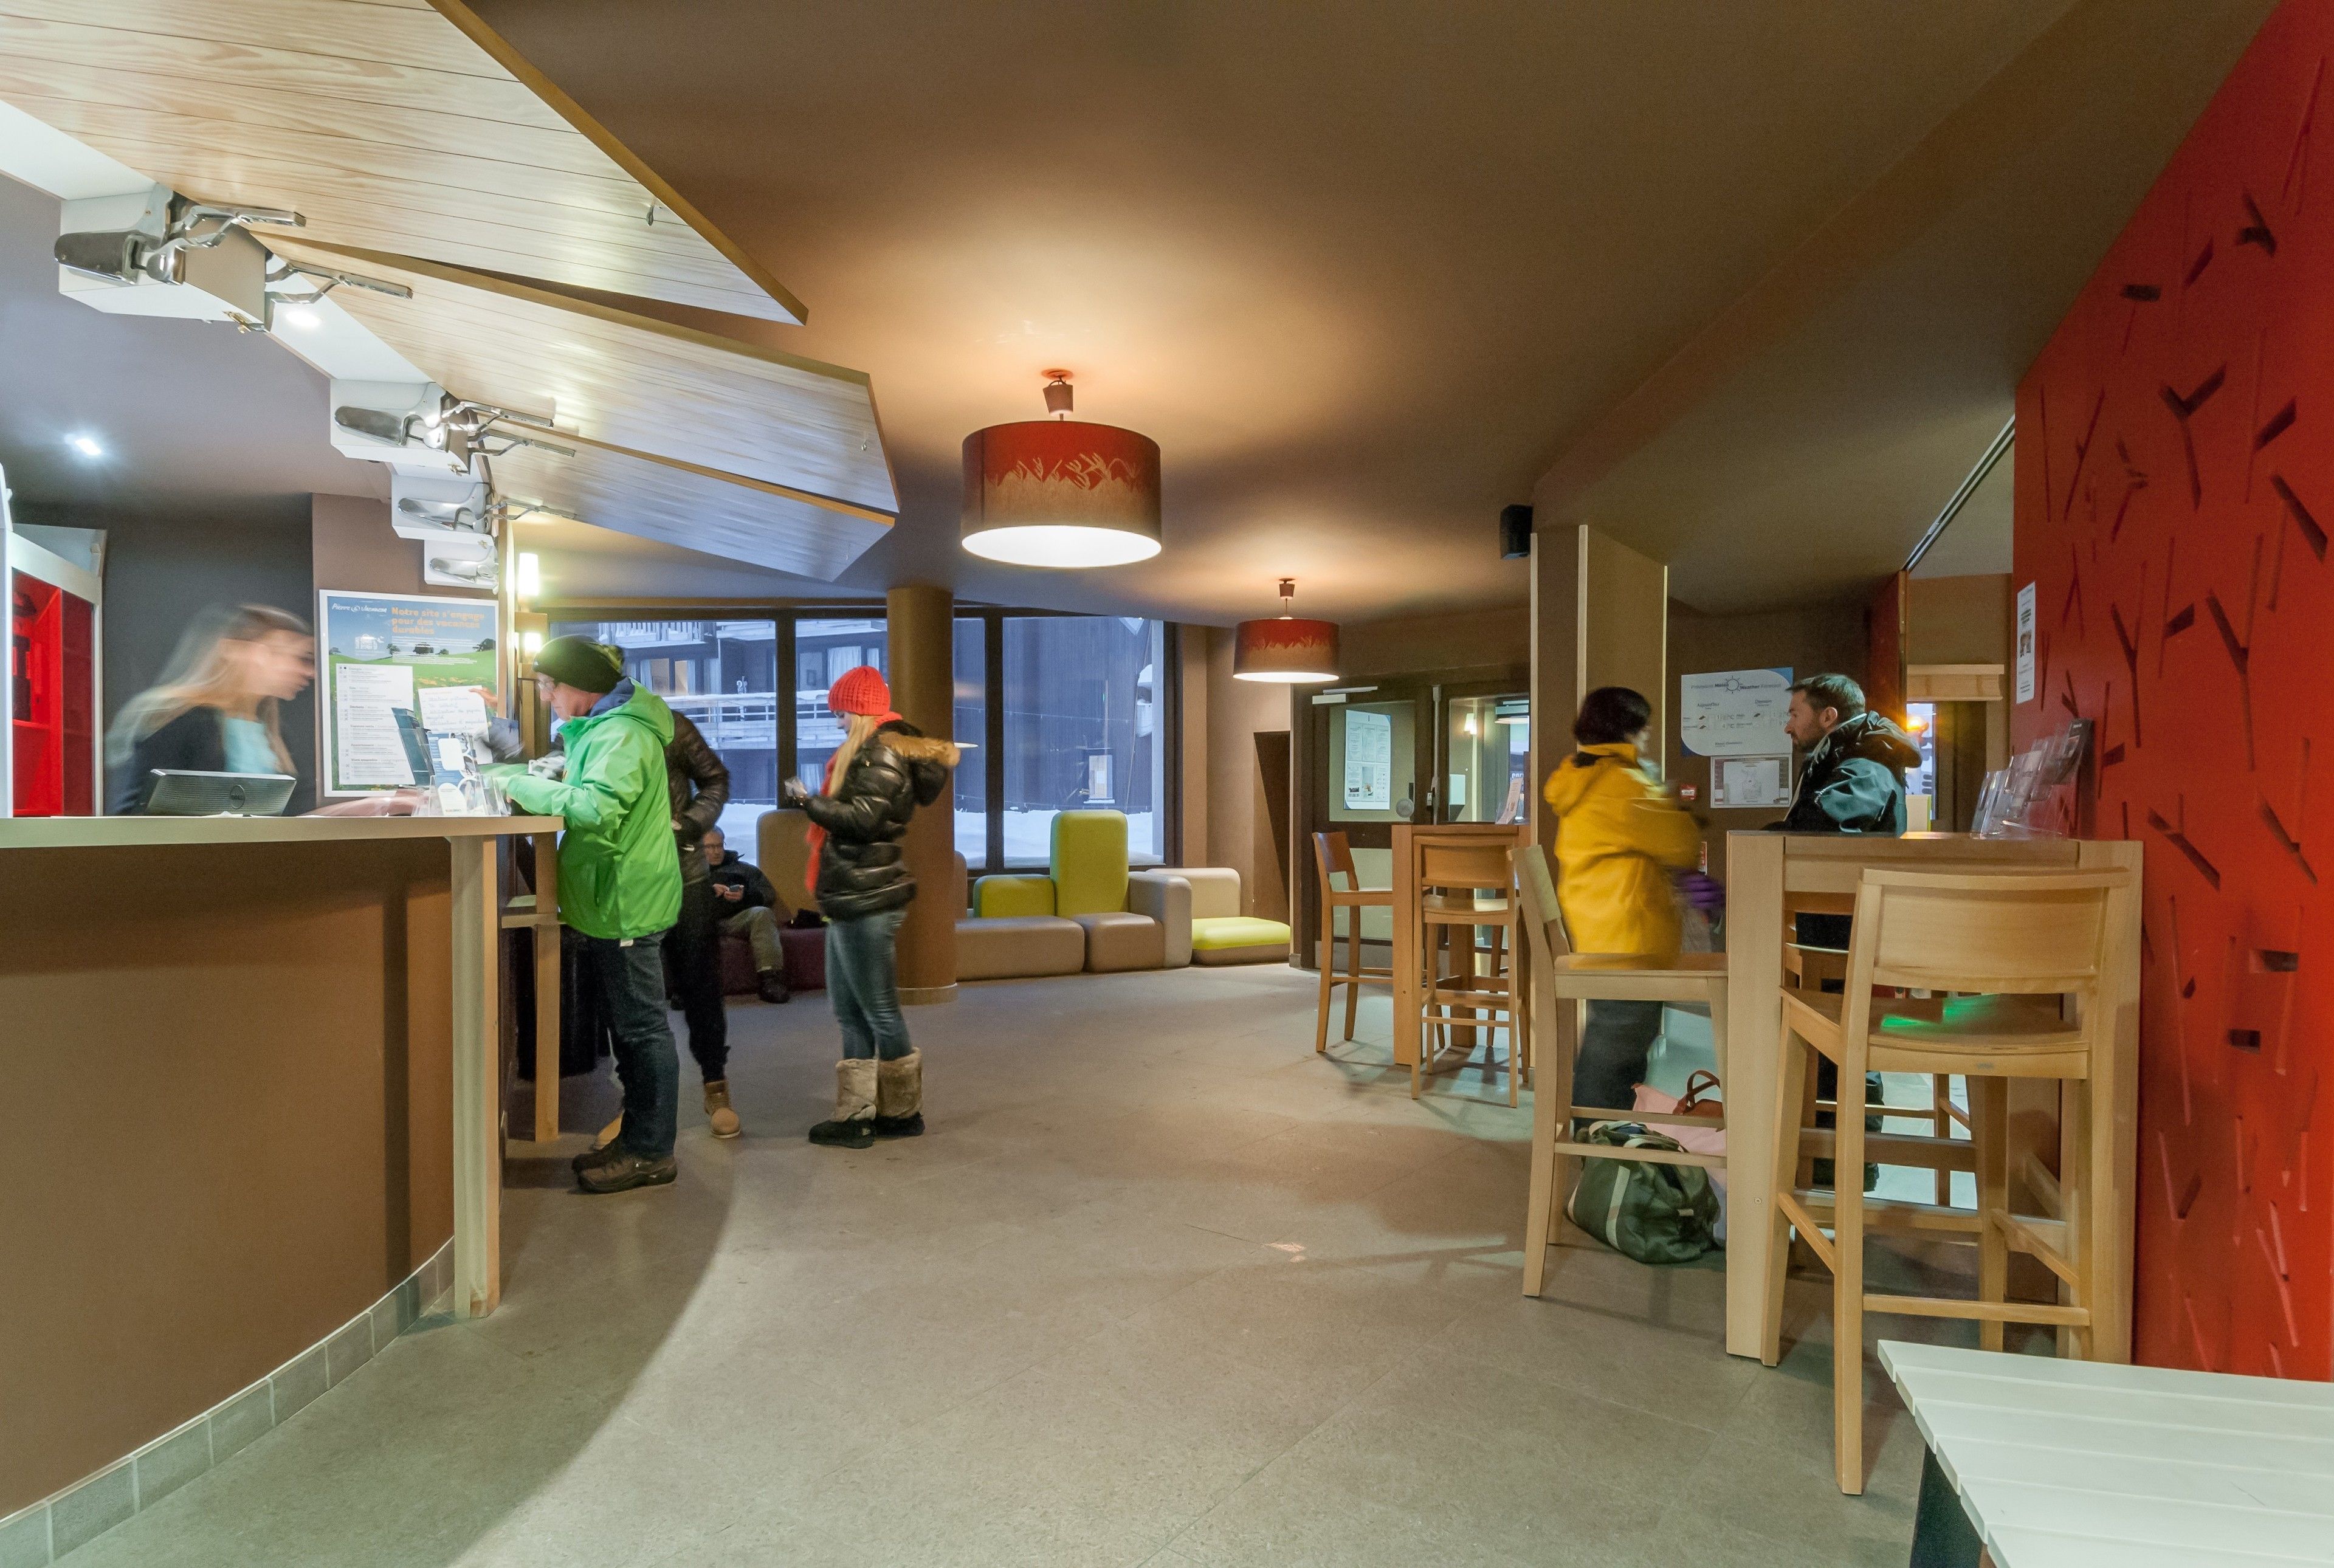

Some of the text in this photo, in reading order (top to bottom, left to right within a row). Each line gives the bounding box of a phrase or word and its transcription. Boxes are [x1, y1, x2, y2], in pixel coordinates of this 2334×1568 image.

[391, 607, 419, 616] Notre
[442, 611, 484, 622] s'engage
[392, 626, 435, 634] durables
